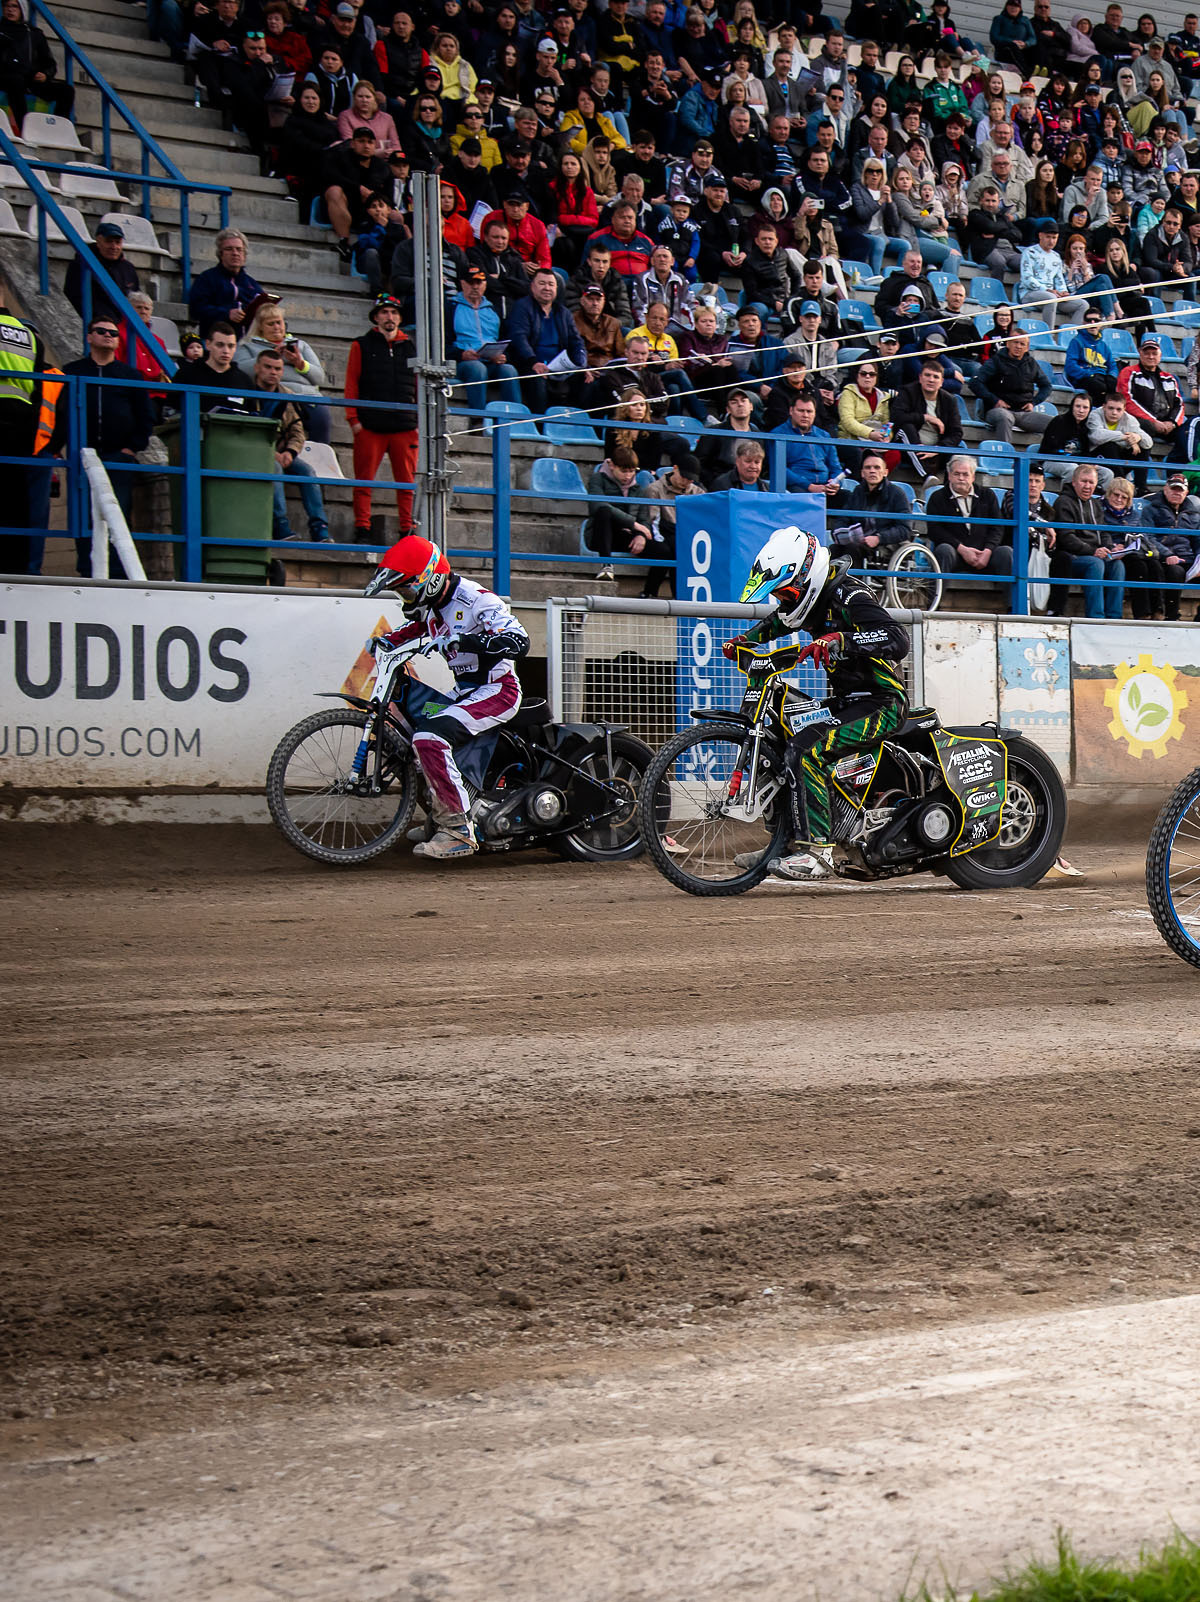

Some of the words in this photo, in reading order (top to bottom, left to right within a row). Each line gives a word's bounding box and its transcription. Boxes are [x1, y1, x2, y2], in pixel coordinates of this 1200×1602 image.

[0, 620, 250, 703] UDIOS
[946, 743, 1002, 773] METALIKA
[959, 759, 994, 780] ACDC
